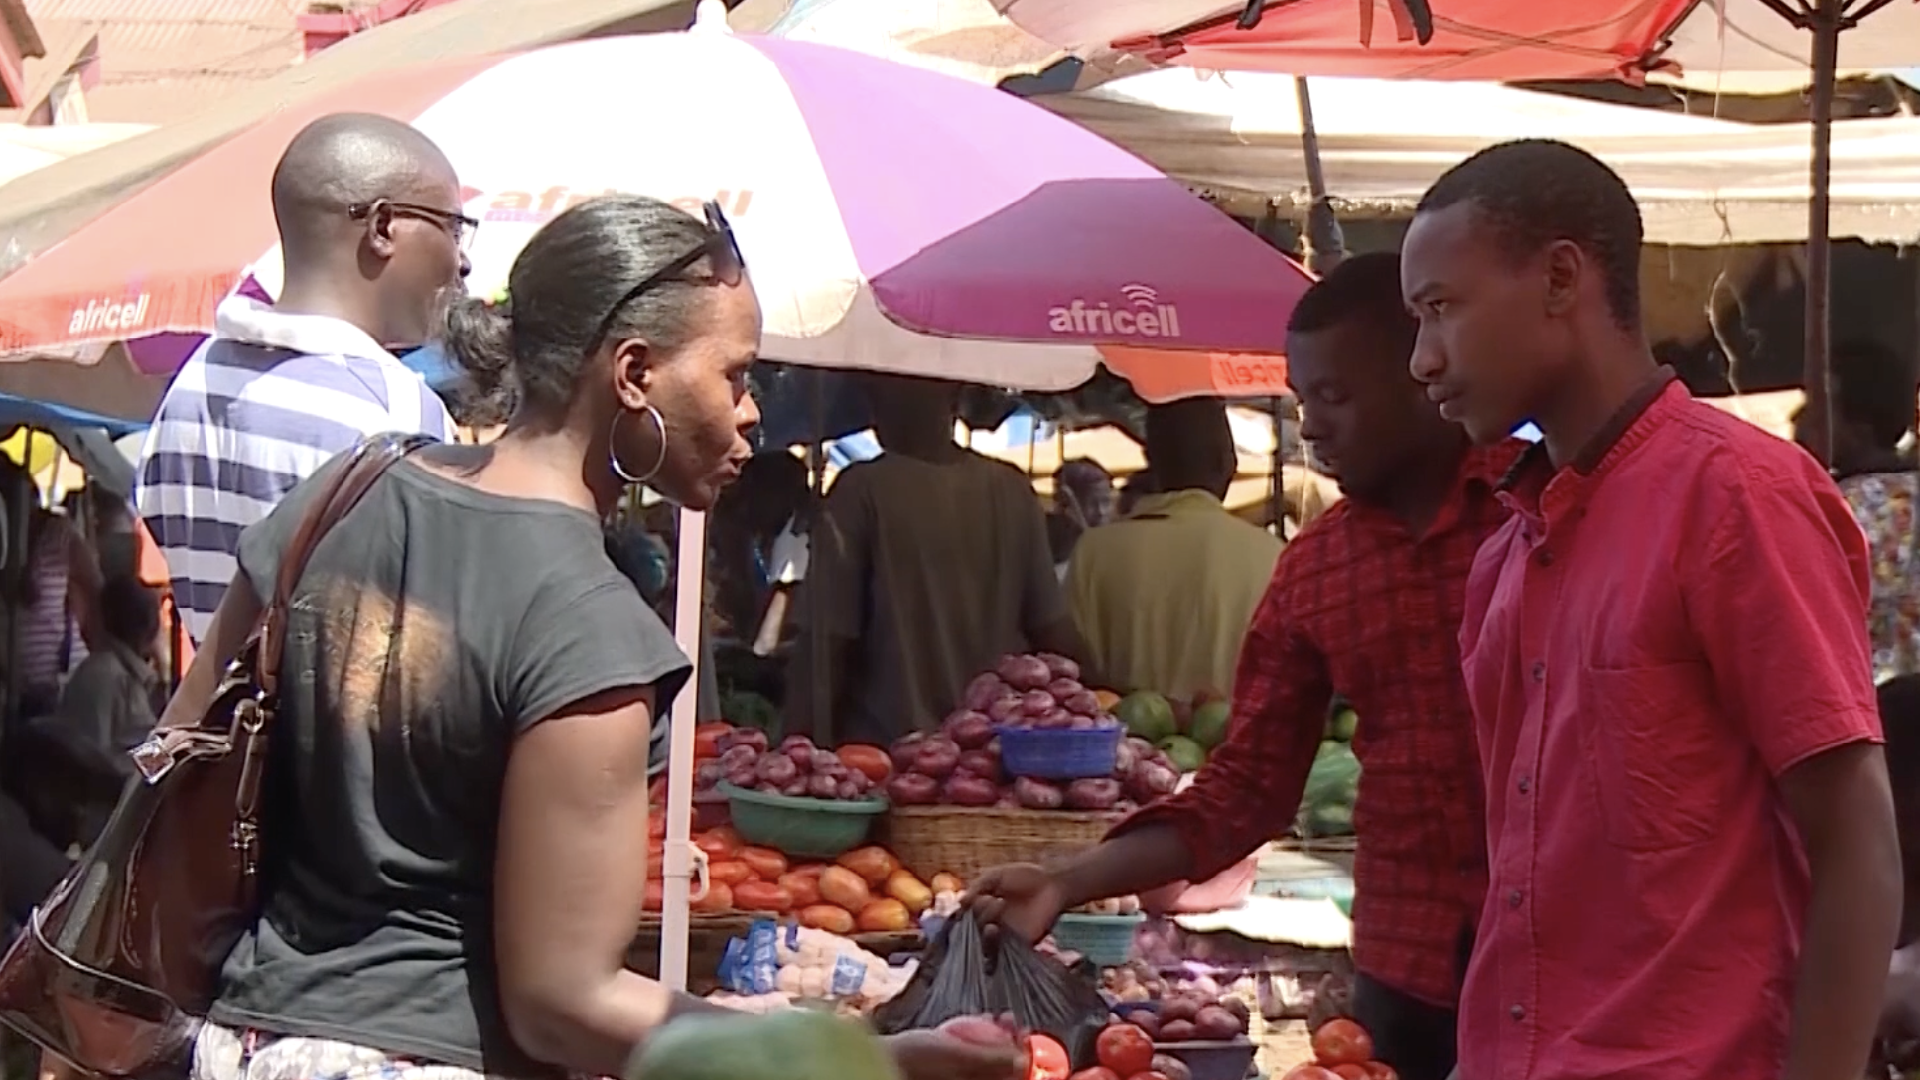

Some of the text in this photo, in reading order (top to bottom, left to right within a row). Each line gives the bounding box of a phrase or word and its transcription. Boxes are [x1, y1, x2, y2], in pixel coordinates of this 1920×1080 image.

[489, 186, 754, 217] afell
[68, 293, 150, 334] africell
[1049, 299, 1181, 337] africell
